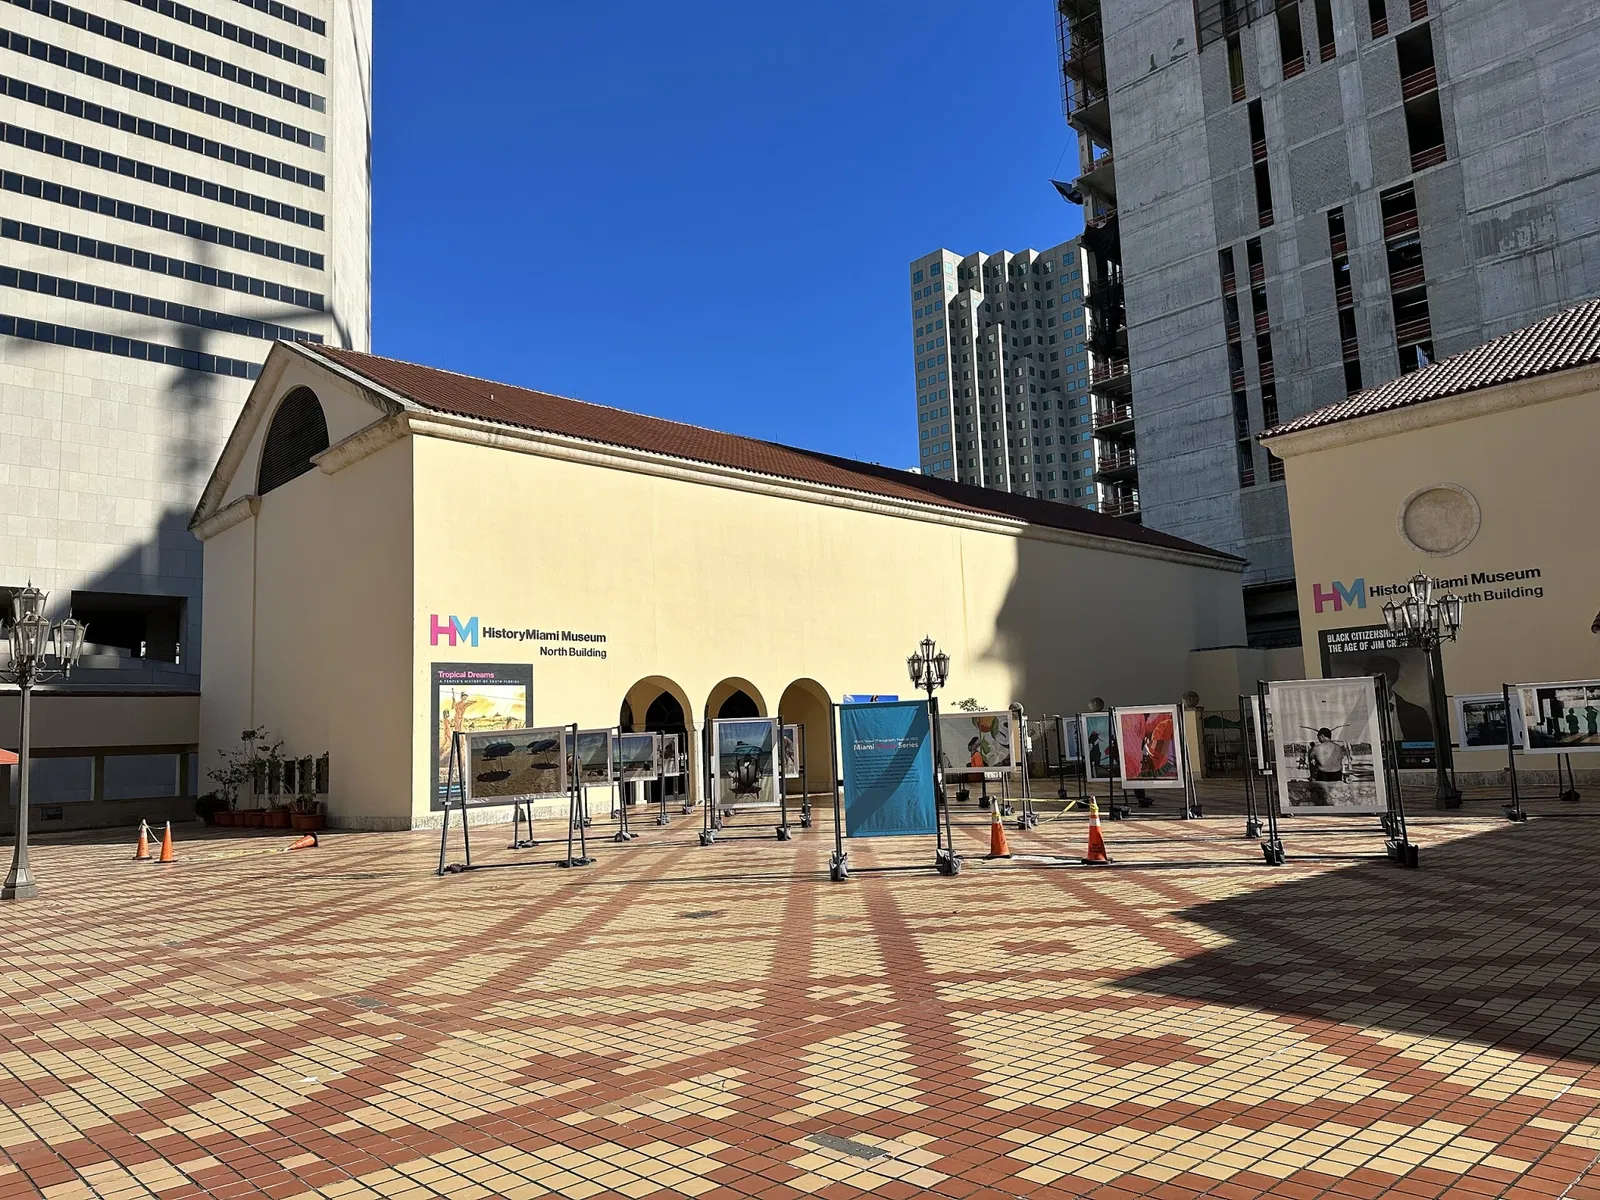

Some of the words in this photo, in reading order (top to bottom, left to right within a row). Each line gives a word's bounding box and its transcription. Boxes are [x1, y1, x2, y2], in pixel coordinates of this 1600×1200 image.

[1471, 567, 1541, 585] Museum
[1312, 577, 1367, 613] HM
[1484, 586, 1544, 601] Building
[430, 614, 479, 647] HM
[482, 626, 560, 642] HistoryMiami
[561, 631, 607, 643] Museum
[1327, 632, 1350, 643] BLACK
[540, 646, 567, 657] North
[568, 647, 607, 659] Building
[1328, 643, 1342, 653] THE
[1344, 642, 1358, 652] AGE
[1359, 641, 1369, 651] OF
[1370, 640, 1385, 650] JIM
[438, 671, 466, 679] Tropical
[467, 671, 495, 679] Dreams
